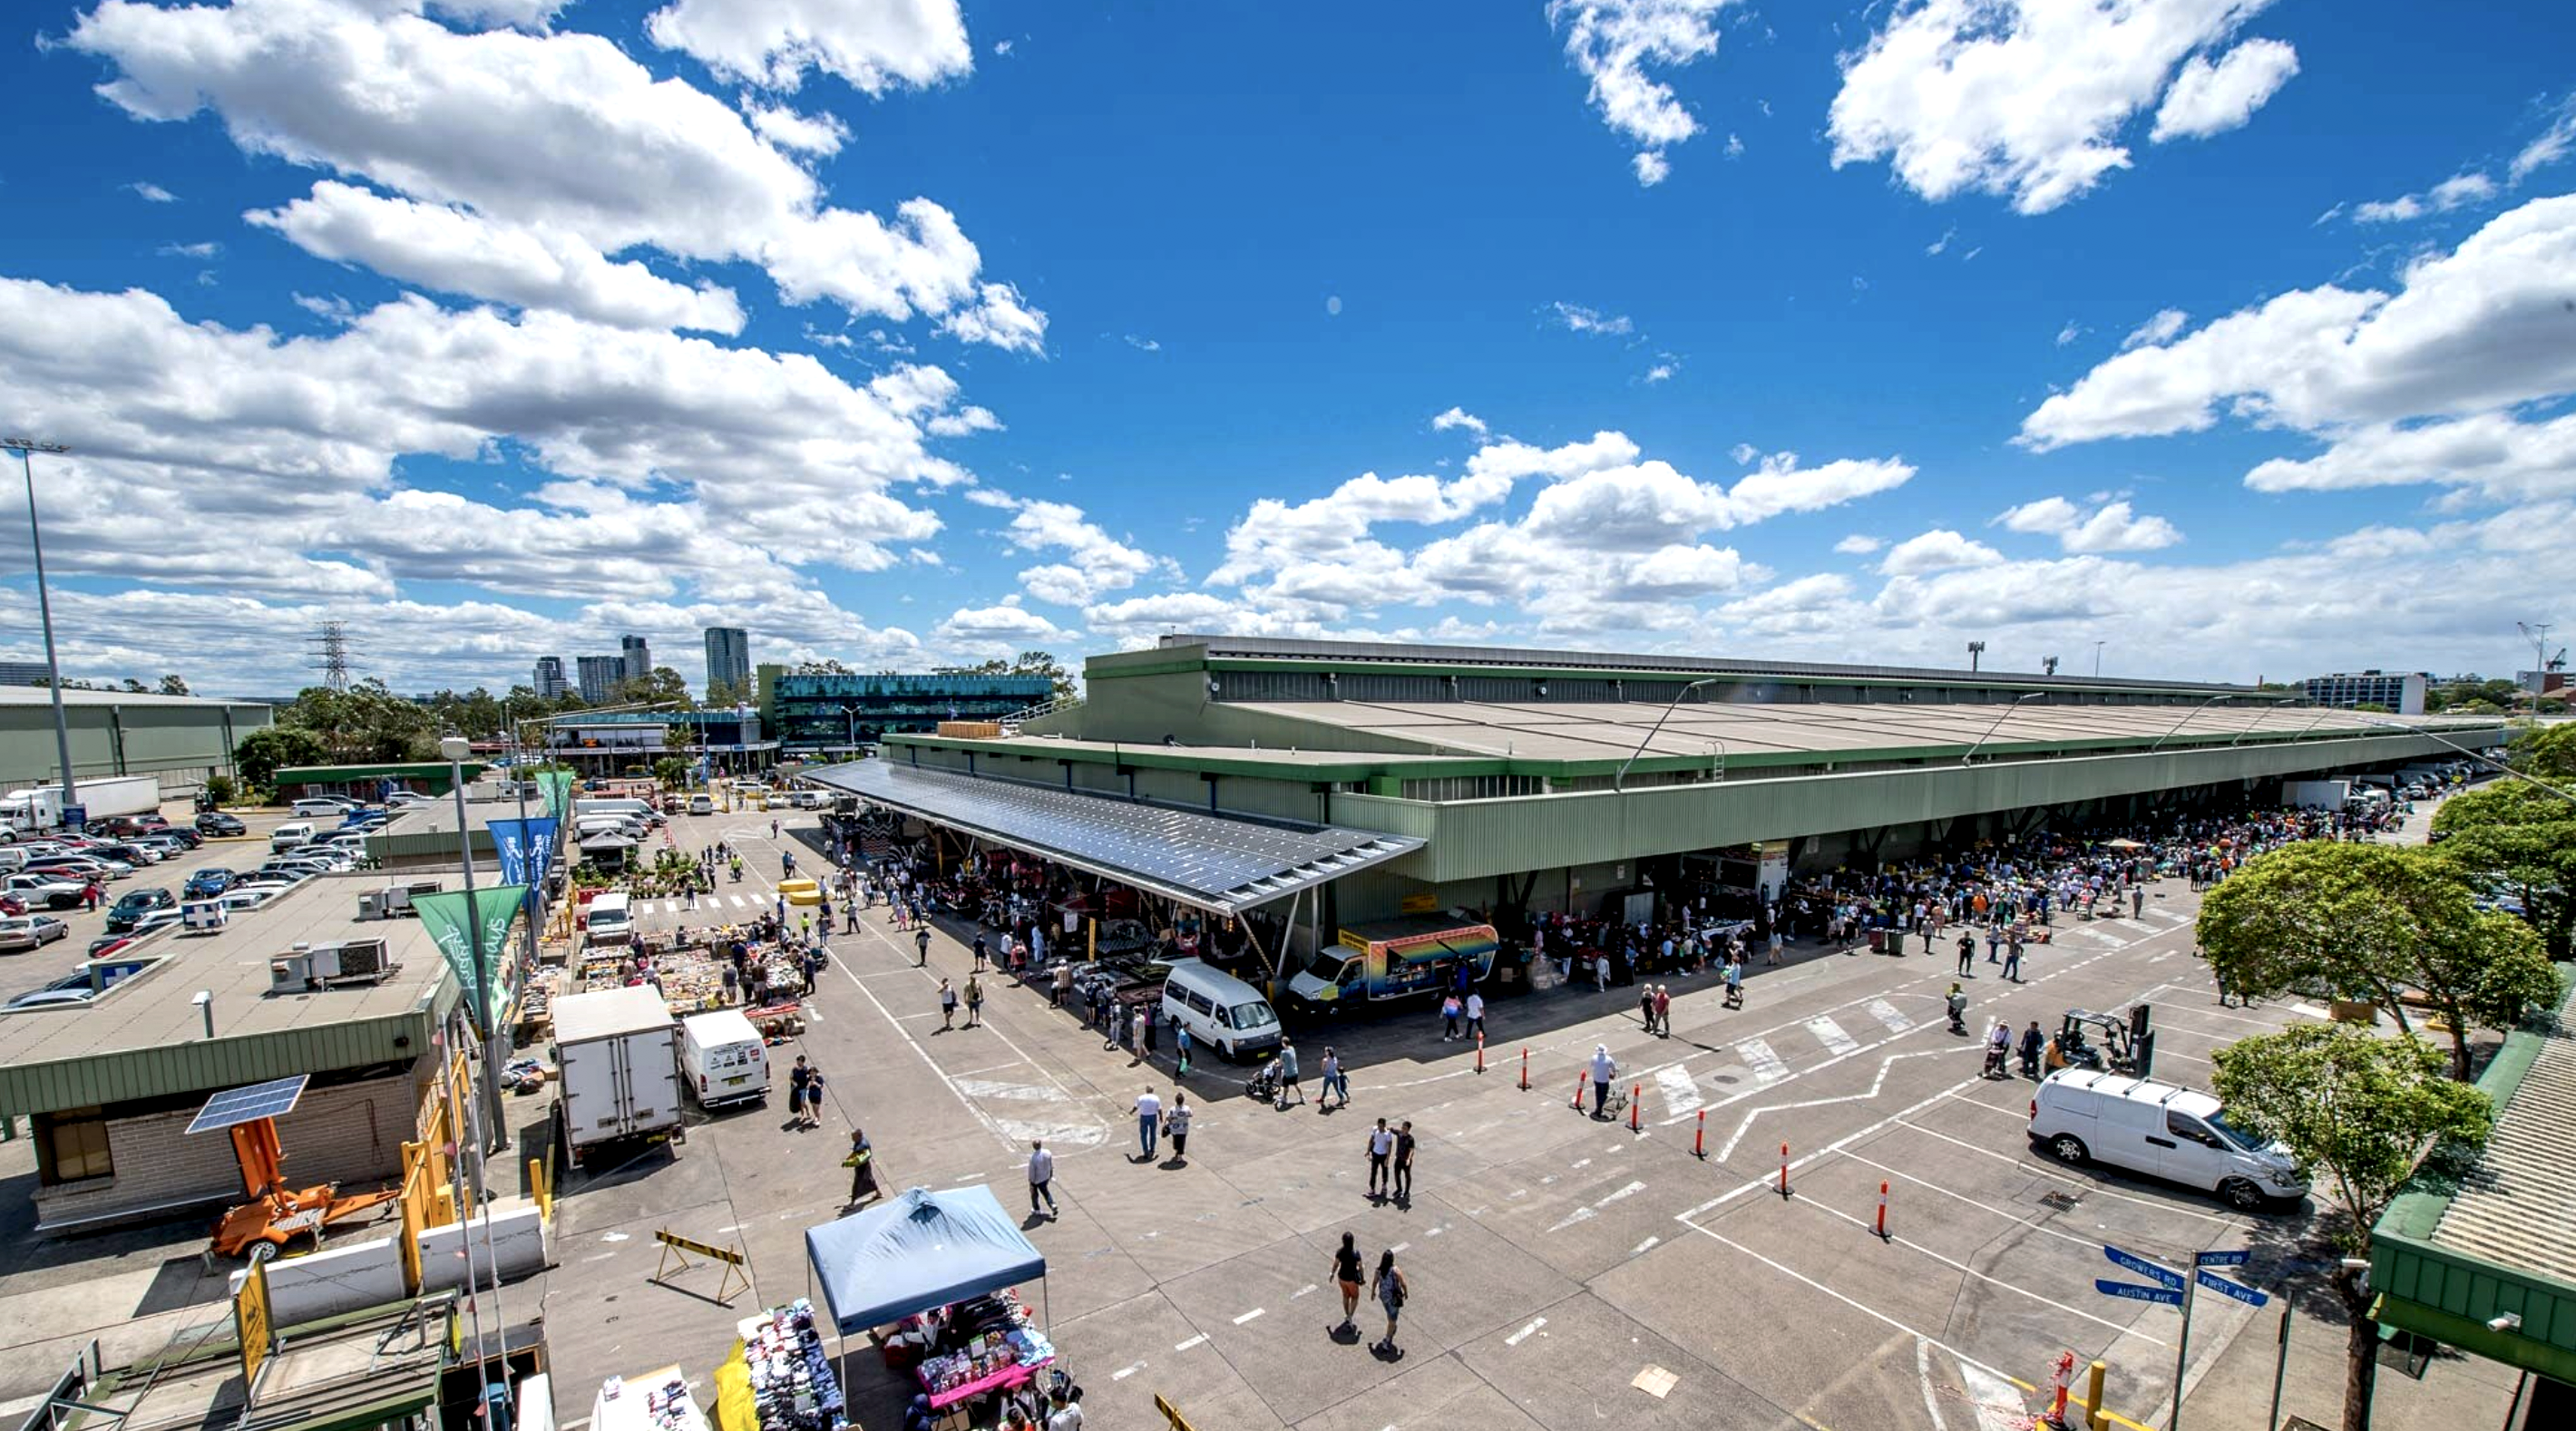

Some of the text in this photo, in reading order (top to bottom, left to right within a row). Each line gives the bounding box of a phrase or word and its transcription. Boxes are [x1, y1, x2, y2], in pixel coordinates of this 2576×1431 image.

[2200, 1255, 2242, 1265] CENTRE RD
[2119, 1256, 2177, 1286] GROWERS RD
[2116, 1288, 2172, 1303] AUSTIN AVE
[2201, 1276, 2253, 1303] FIRST AVE
